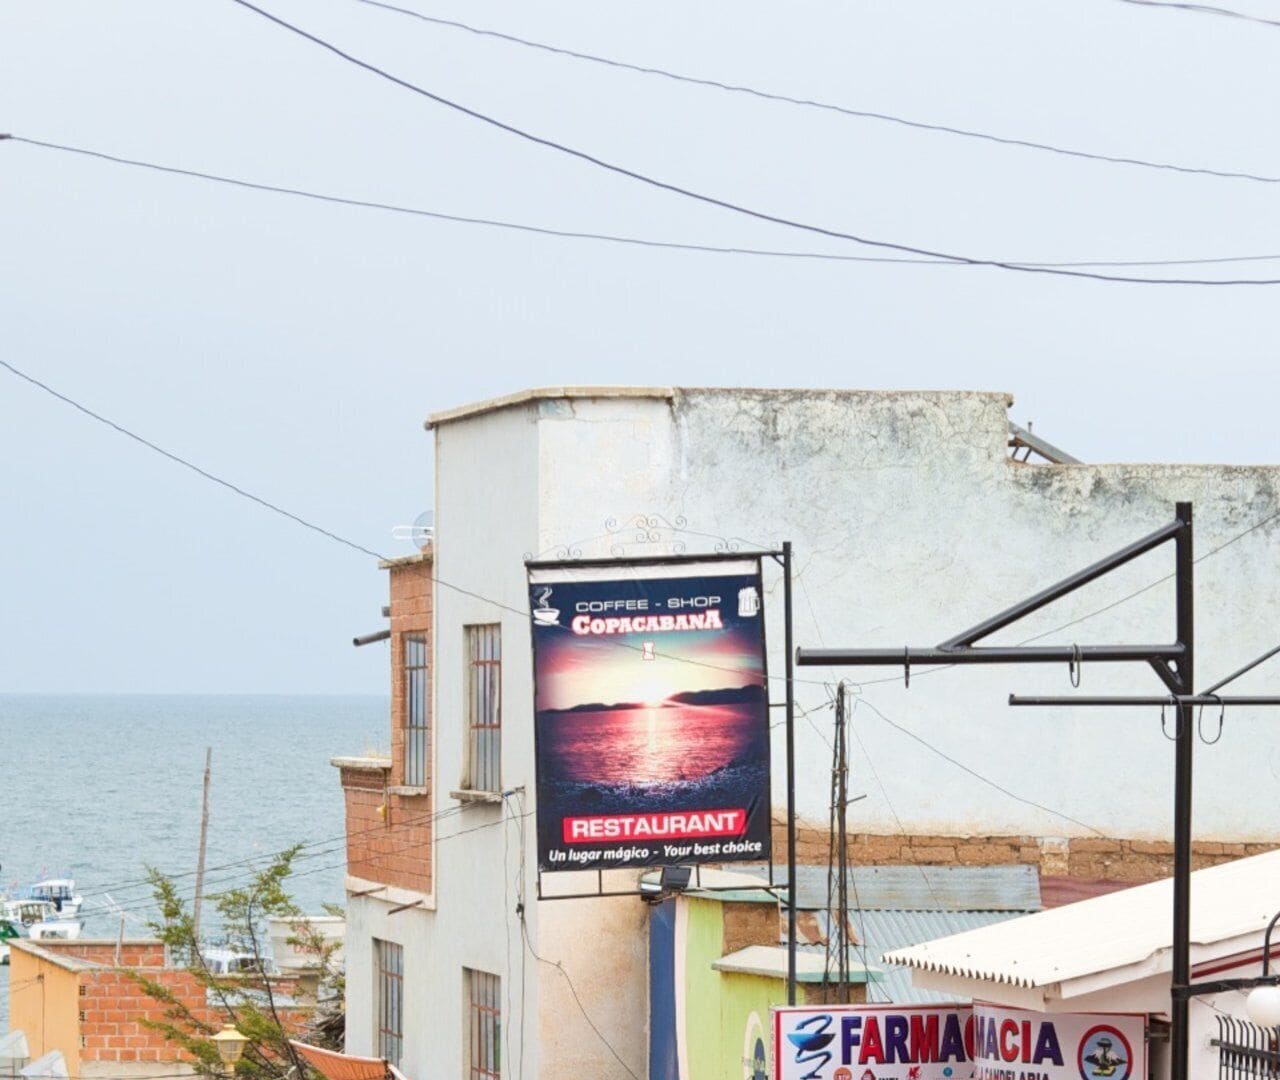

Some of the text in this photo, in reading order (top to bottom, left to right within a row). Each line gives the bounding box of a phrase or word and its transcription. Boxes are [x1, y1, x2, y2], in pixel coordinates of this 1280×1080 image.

[576, 599, 649, 612] COFFEE
[667, 596, 721, 608] SHOP
[572, 609, 723, 635] COPACABANA
[572, 813, 738, 838] RESTAURANT
[549, 849, 565, 862] Un
[569, 849, 601, 864] lugar
[604, 847, 649, 863] mágico
[664, 844, 691, 857] Your
[694, 842, 720, 855] best
[722, 841, 762, 854] choice
